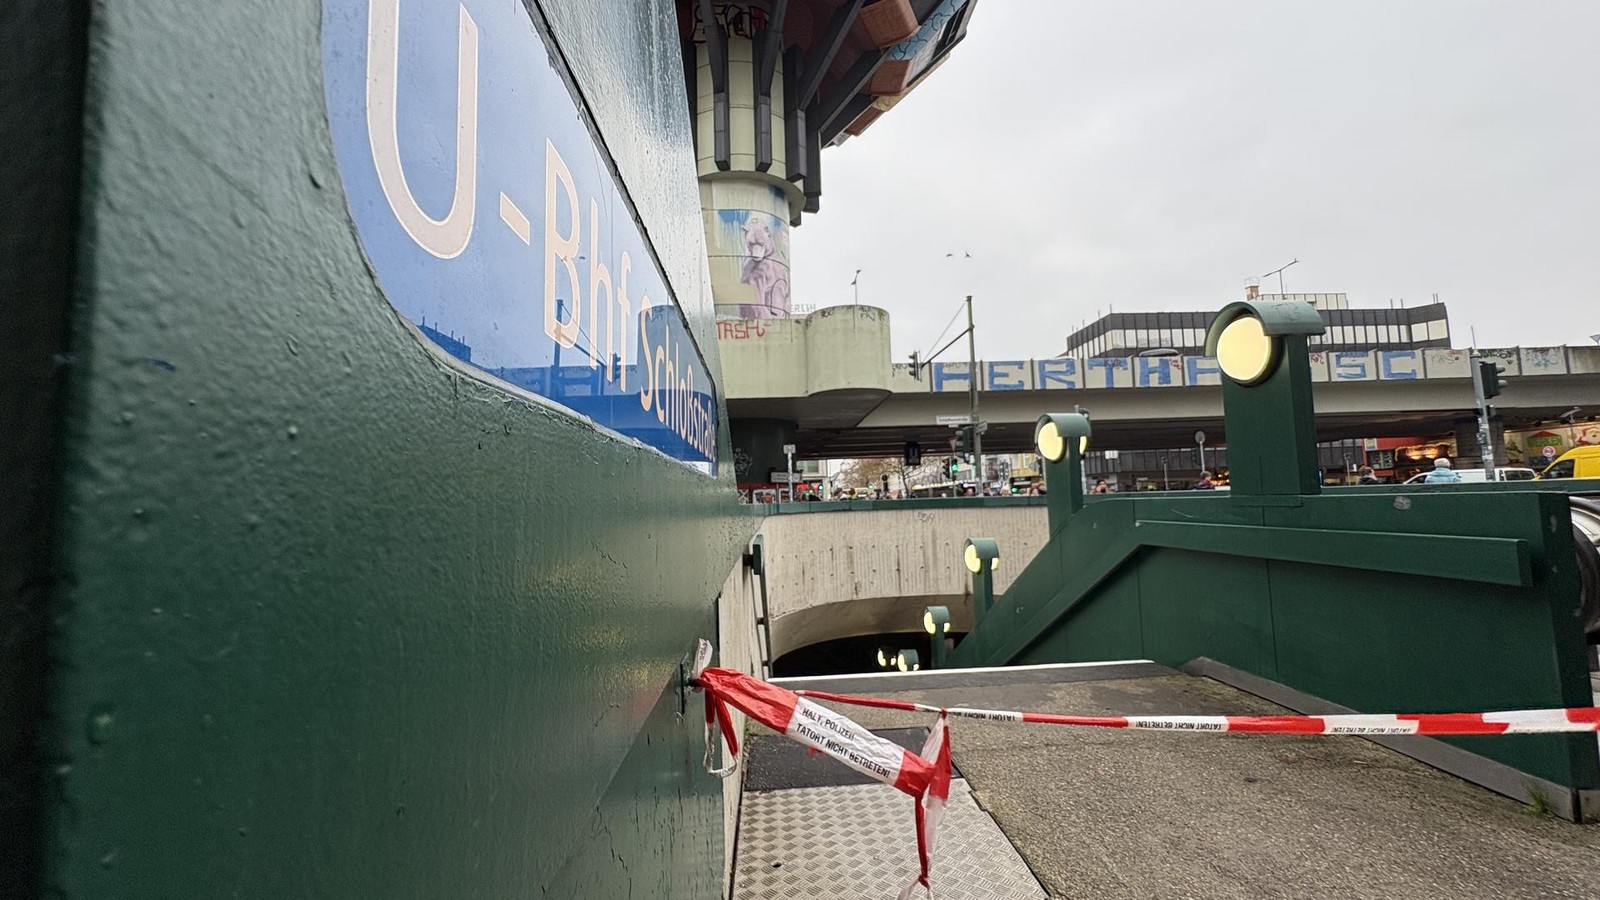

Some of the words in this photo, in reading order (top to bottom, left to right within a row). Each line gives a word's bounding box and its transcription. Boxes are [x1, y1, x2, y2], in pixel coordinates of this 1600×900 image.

[366, 0, 632, 393] U-Bhf
[640, 295, 717, 463] Schloßstraße
[791, 303, 816, 313] ERLIN
[1335, 350, 1418, 380] SC
[1135, 720, 1173, 729] BETRETEN!
[1174, 722, 1195, 730] NICHT
[1195, 723, 1222, 731] TATORT
[796, 722, 826, 745] TATORT
[825, 739, 848, 756] NICHT
[849, 751, 891, 779] BETRETEN!
